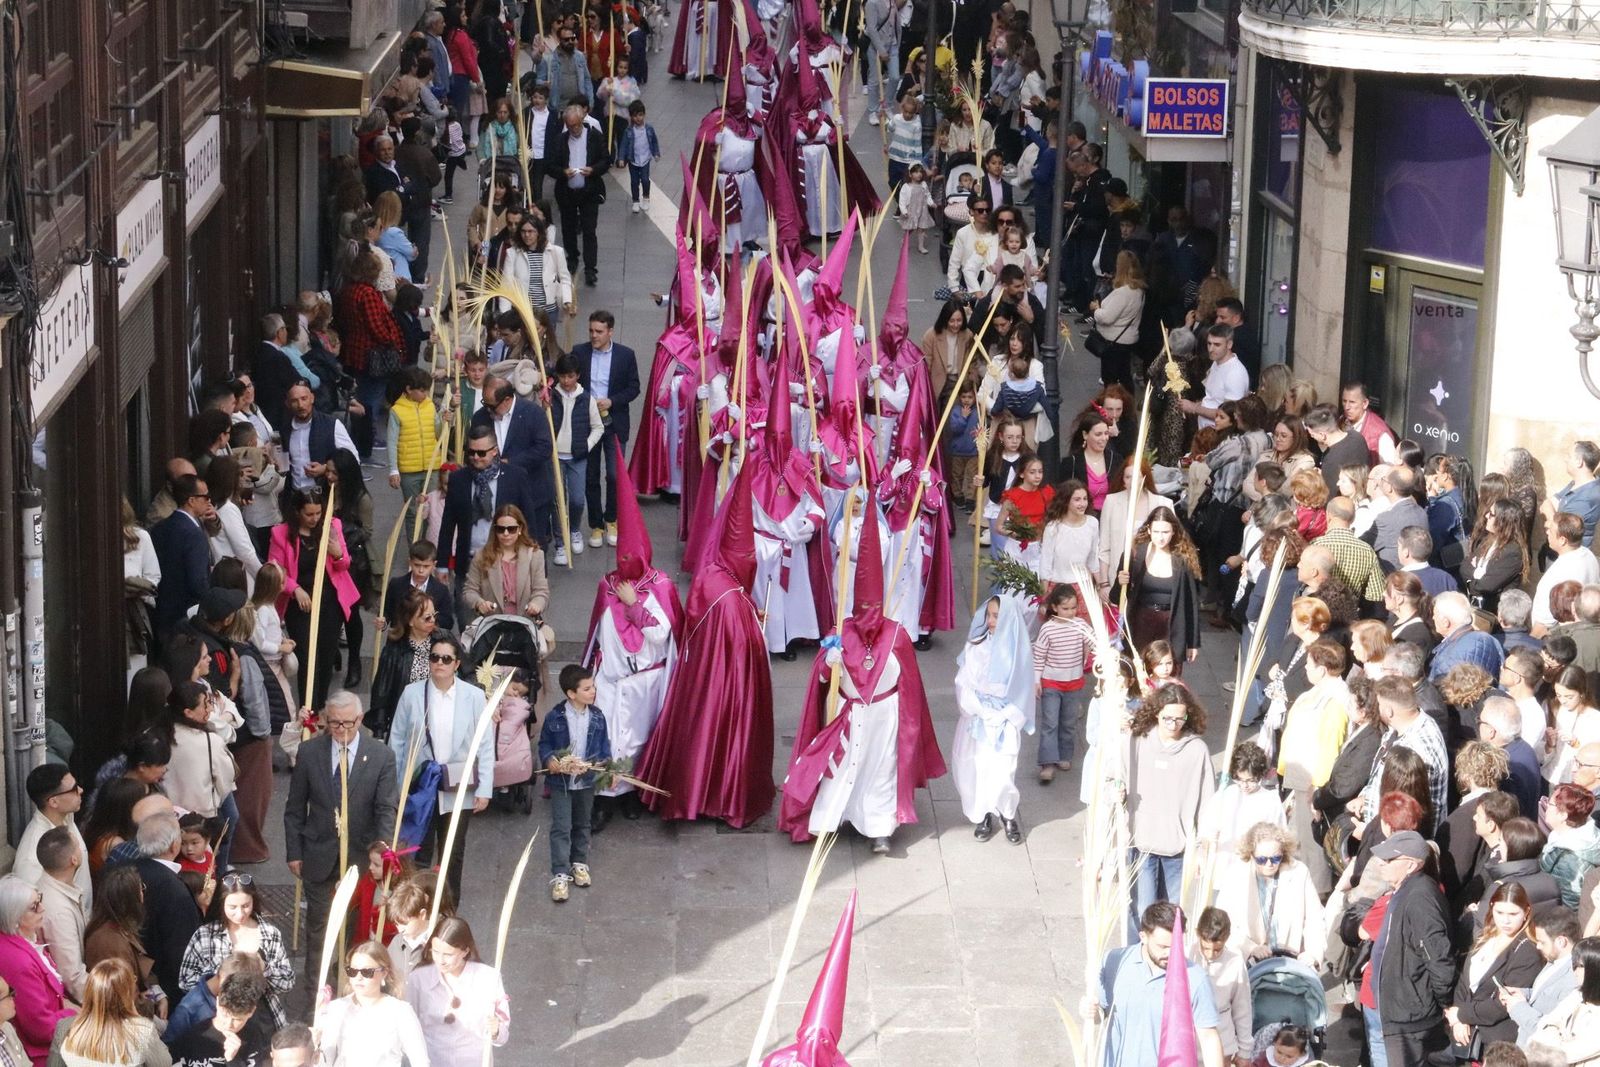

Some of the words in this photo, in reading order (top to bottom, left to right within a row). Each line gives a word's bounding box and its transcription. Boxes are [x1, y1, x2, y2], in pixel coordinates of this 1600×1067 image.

[1154, 87, 1219, 106] BOLSOS
[1148, 112, 1223, 131] MALETAS
[1415, 303, 1465, 318] venta
